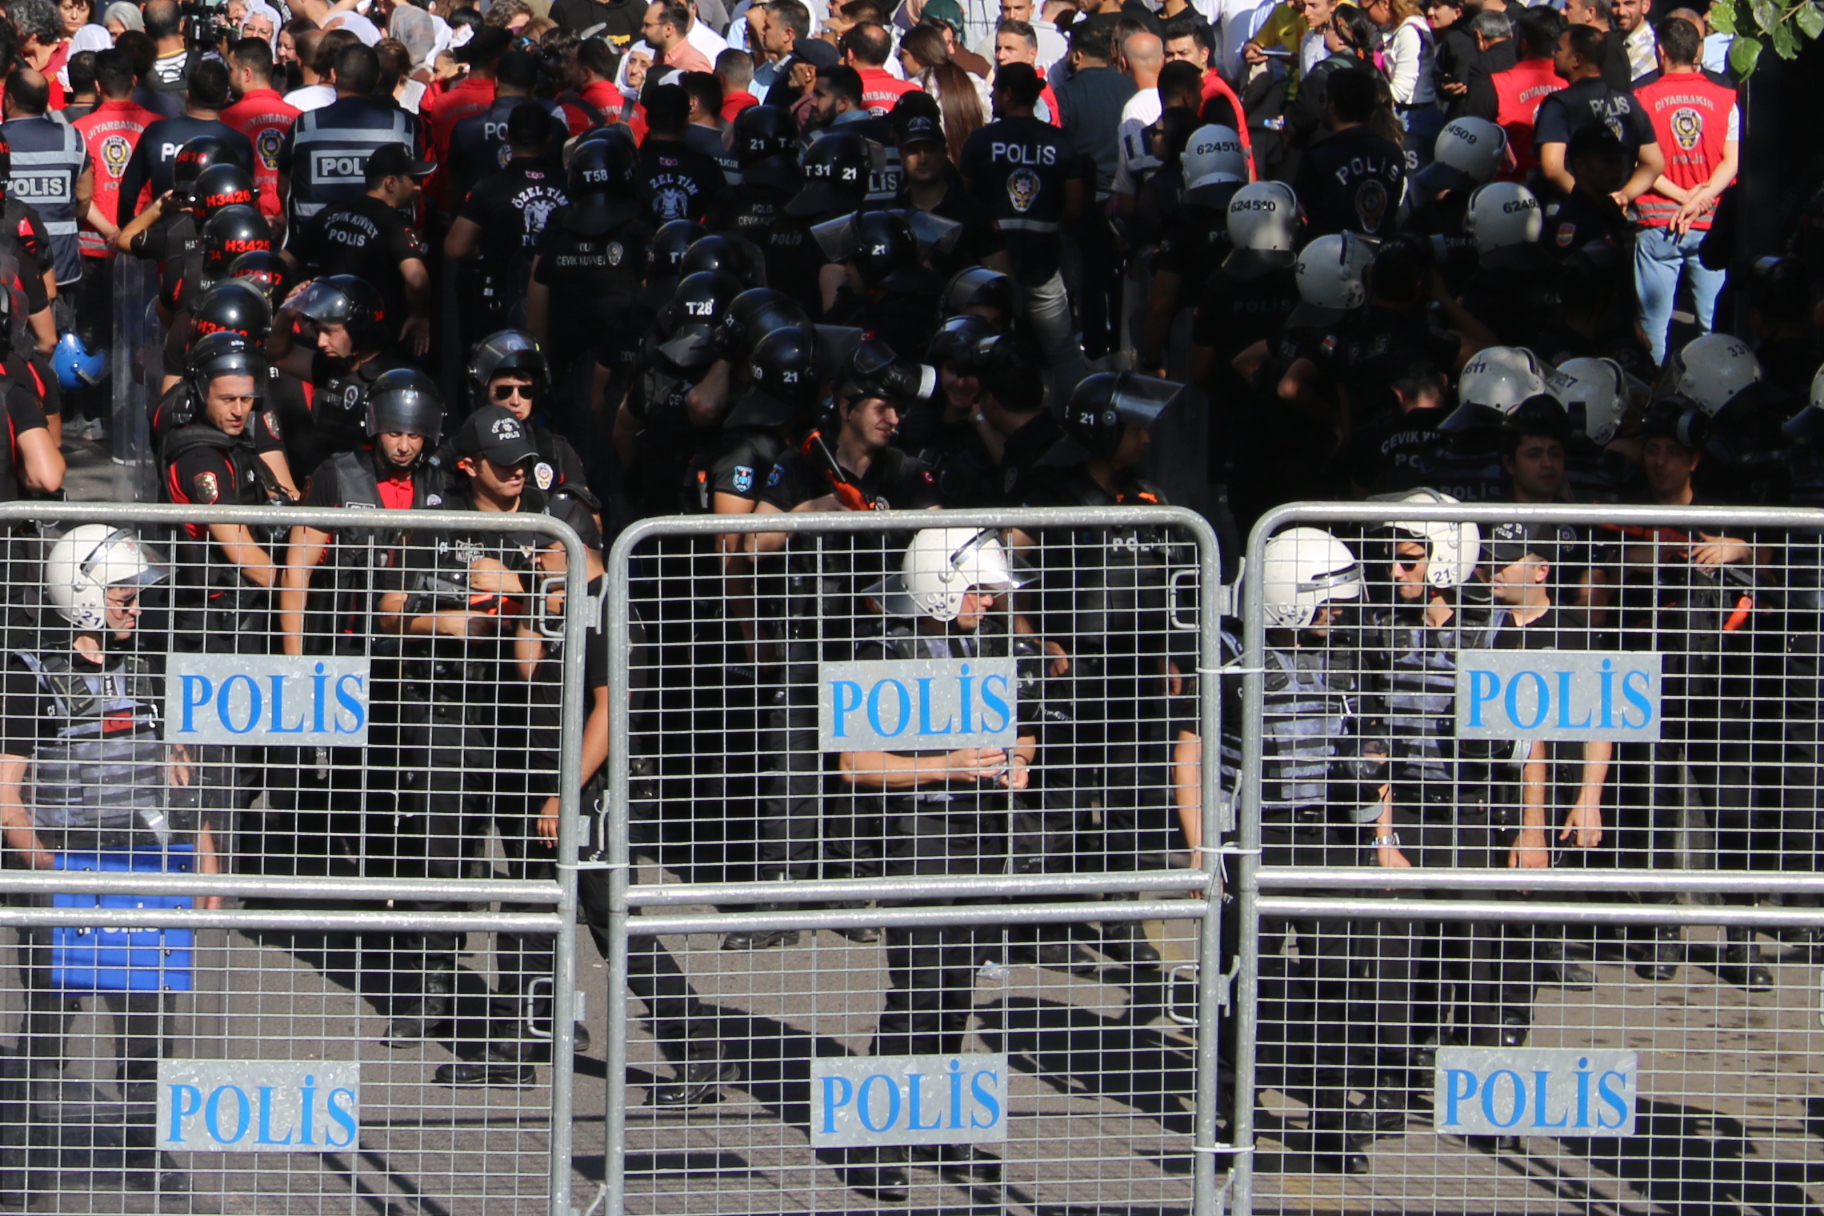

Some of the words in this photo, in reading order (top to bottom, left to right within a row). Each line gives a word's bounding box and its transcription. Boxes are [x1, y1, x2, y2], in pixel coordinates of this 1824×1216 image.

[750, 138, 765, 150] 21
[992, 142, 1056, 165] POLİS
[322, 157, 365, 177] POL
[582, 169, 608, 182] T58
[842, 168, 857, 180] 21
[649, 173, 674, 189] ZEL
[868, 173, 897, 192] LİS
[206, 189, 251, 206] H3426
[512, 185, 543, 209] ÖZEL
[686, 301, 713, 315] T28
[783, 371, 798, 382] 21
[1080, 412, 1094, 425] 21
[1433, 569, 1450, 583] 21
[81, 610, 102, 626] 21
[177, 662, 366, 734] POLİS
[828, 662, 1011, 738] POLİS
[1464, 657, 1653, 730] POLİS
[818, 1058, 1001, 1135] POLİS
[1442, 1056, 1629, 1130] POLİS
[165, 1074, 358, 1148] POLİS
